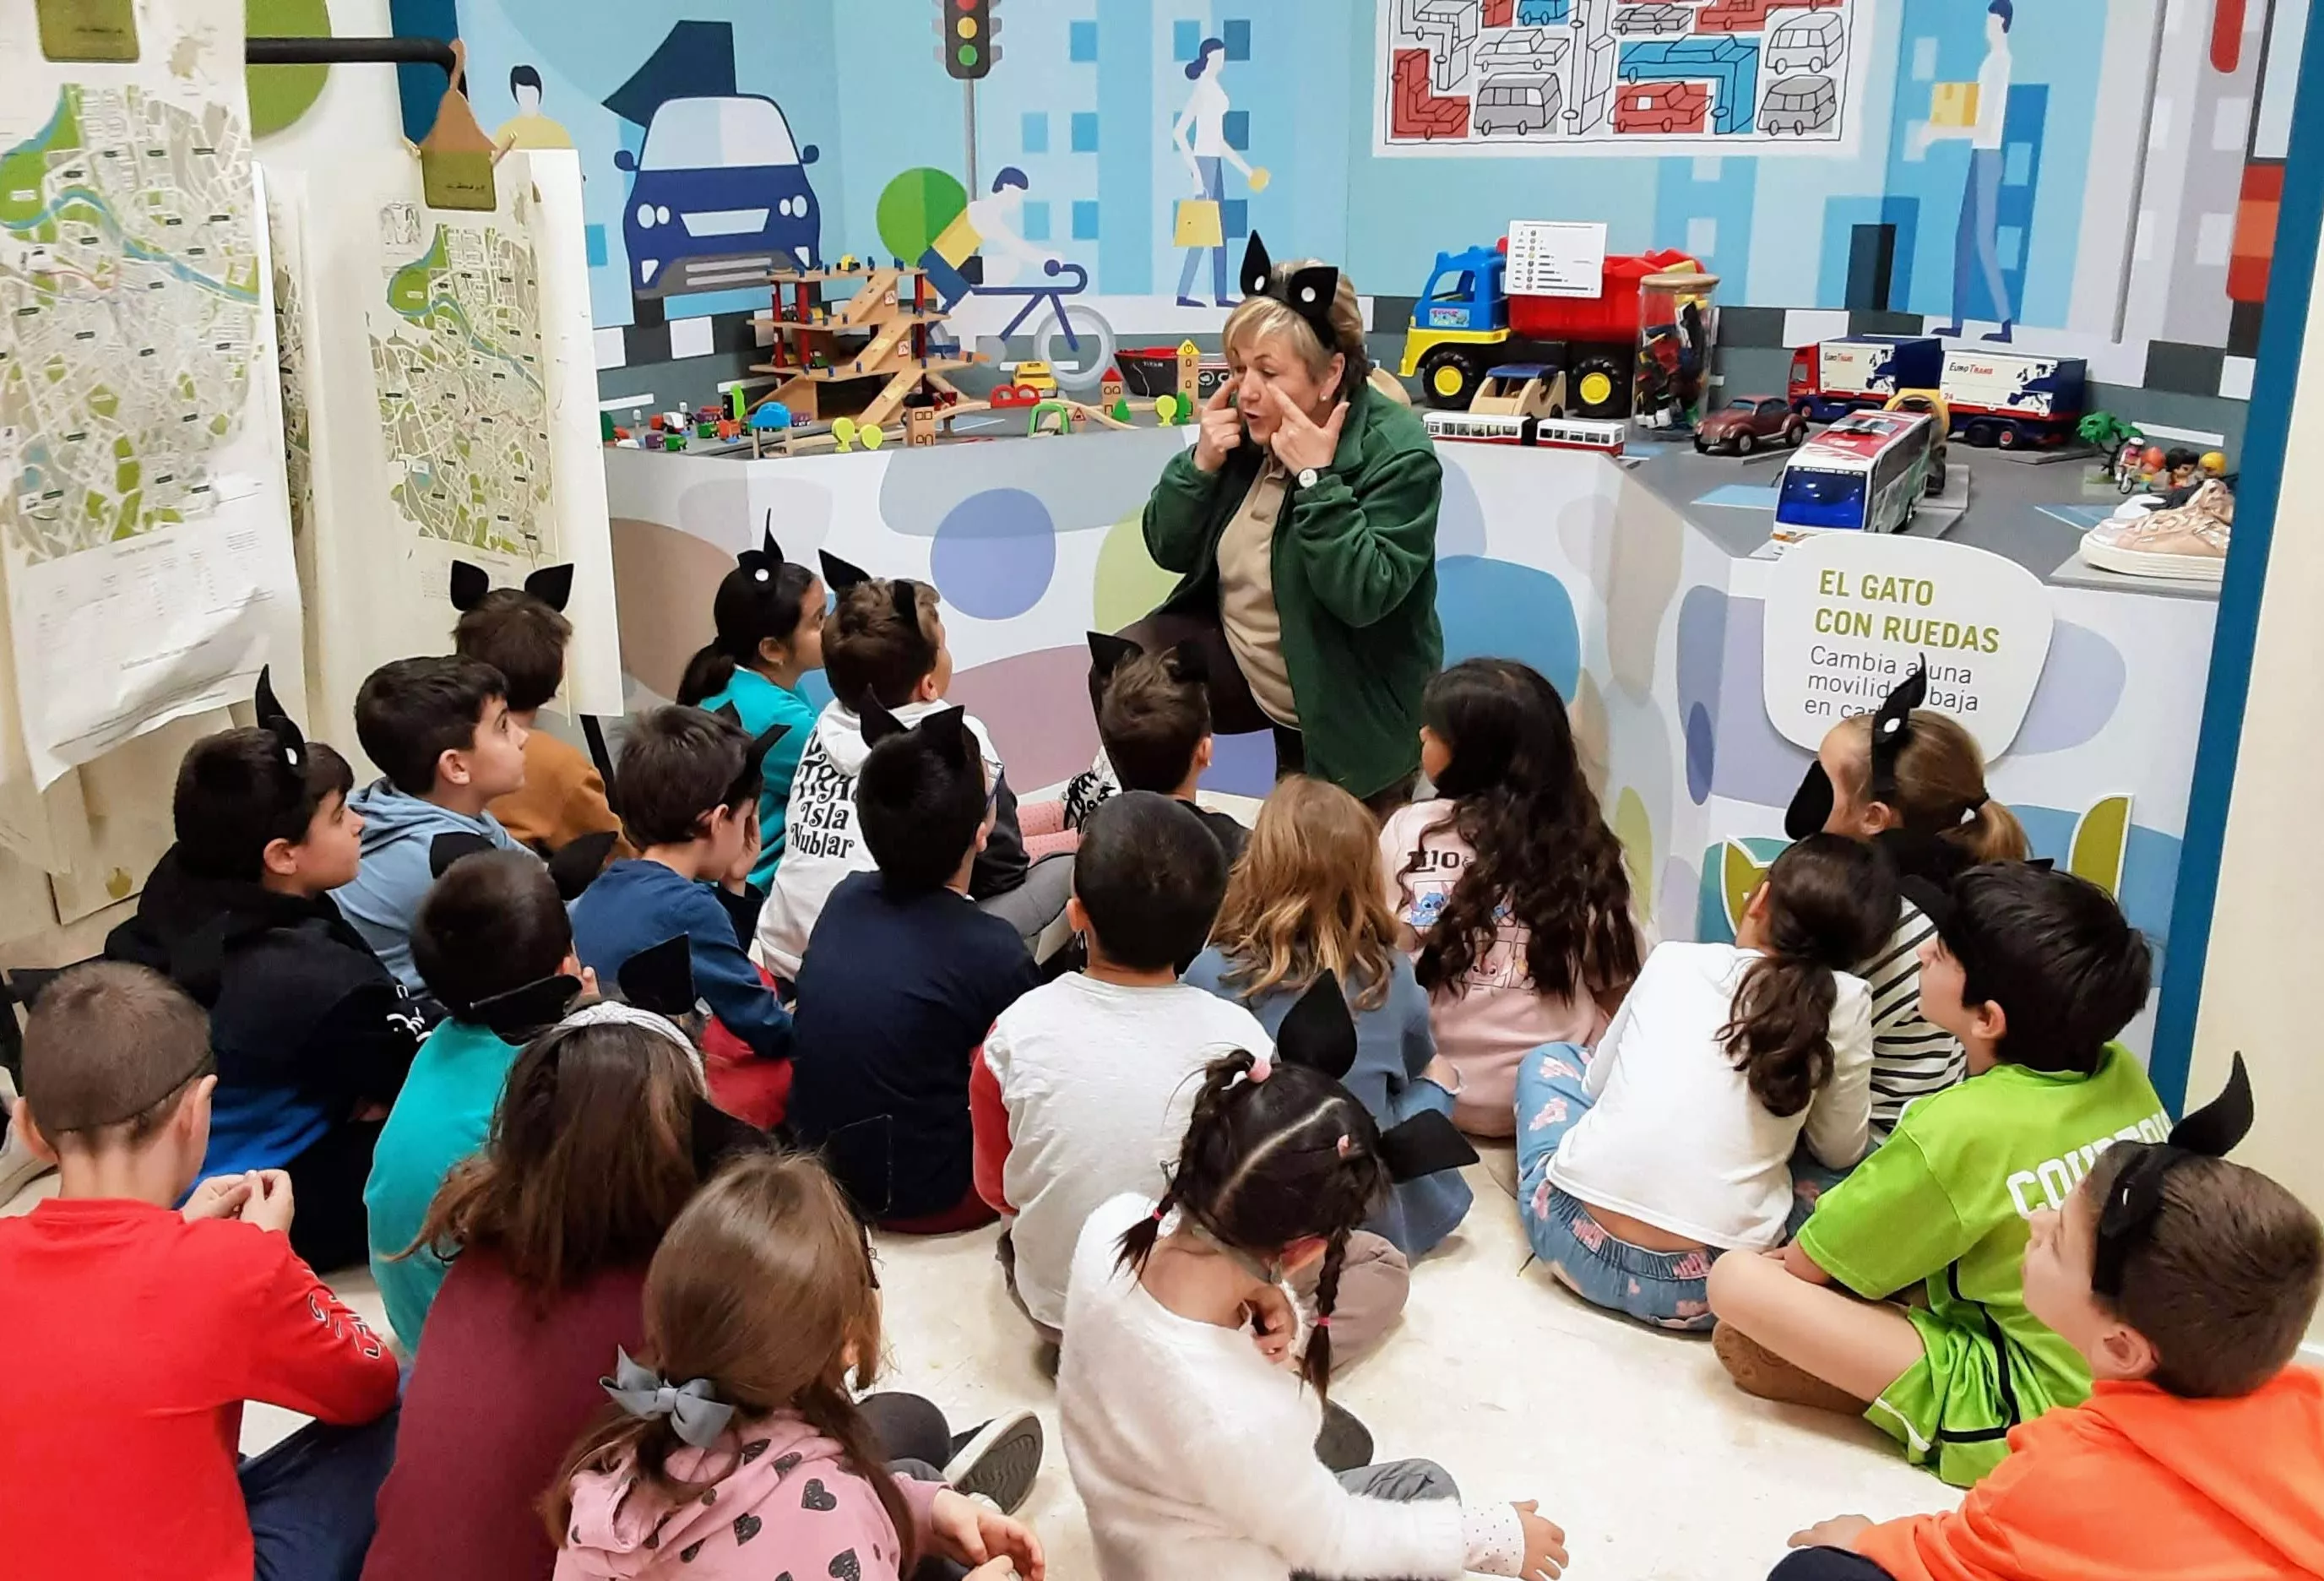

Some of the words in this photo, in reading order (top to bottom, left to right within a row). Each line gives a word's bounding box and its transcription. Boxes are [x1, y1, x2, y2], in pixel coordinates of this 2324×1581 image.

[1819, 569, 1849, 597] EL
[1860, 573, 1935, 606] GATO
[1815, 607, 1873, 638] CON
[1882, 616, 2001, 653] RUEDAS
[1811, 645, 1896, 674] Cambia
[1906, 661, 1919, 676] a
[1929, 665, 1972, 684] una
[1805, 699, 1831, 716] en
[1808, 674, 1895, 699] movilid
[1929, 686, 1978, 714] baja
[800, 801, 850, 830] Isla
[790, 823, 855, 859] Nublar
